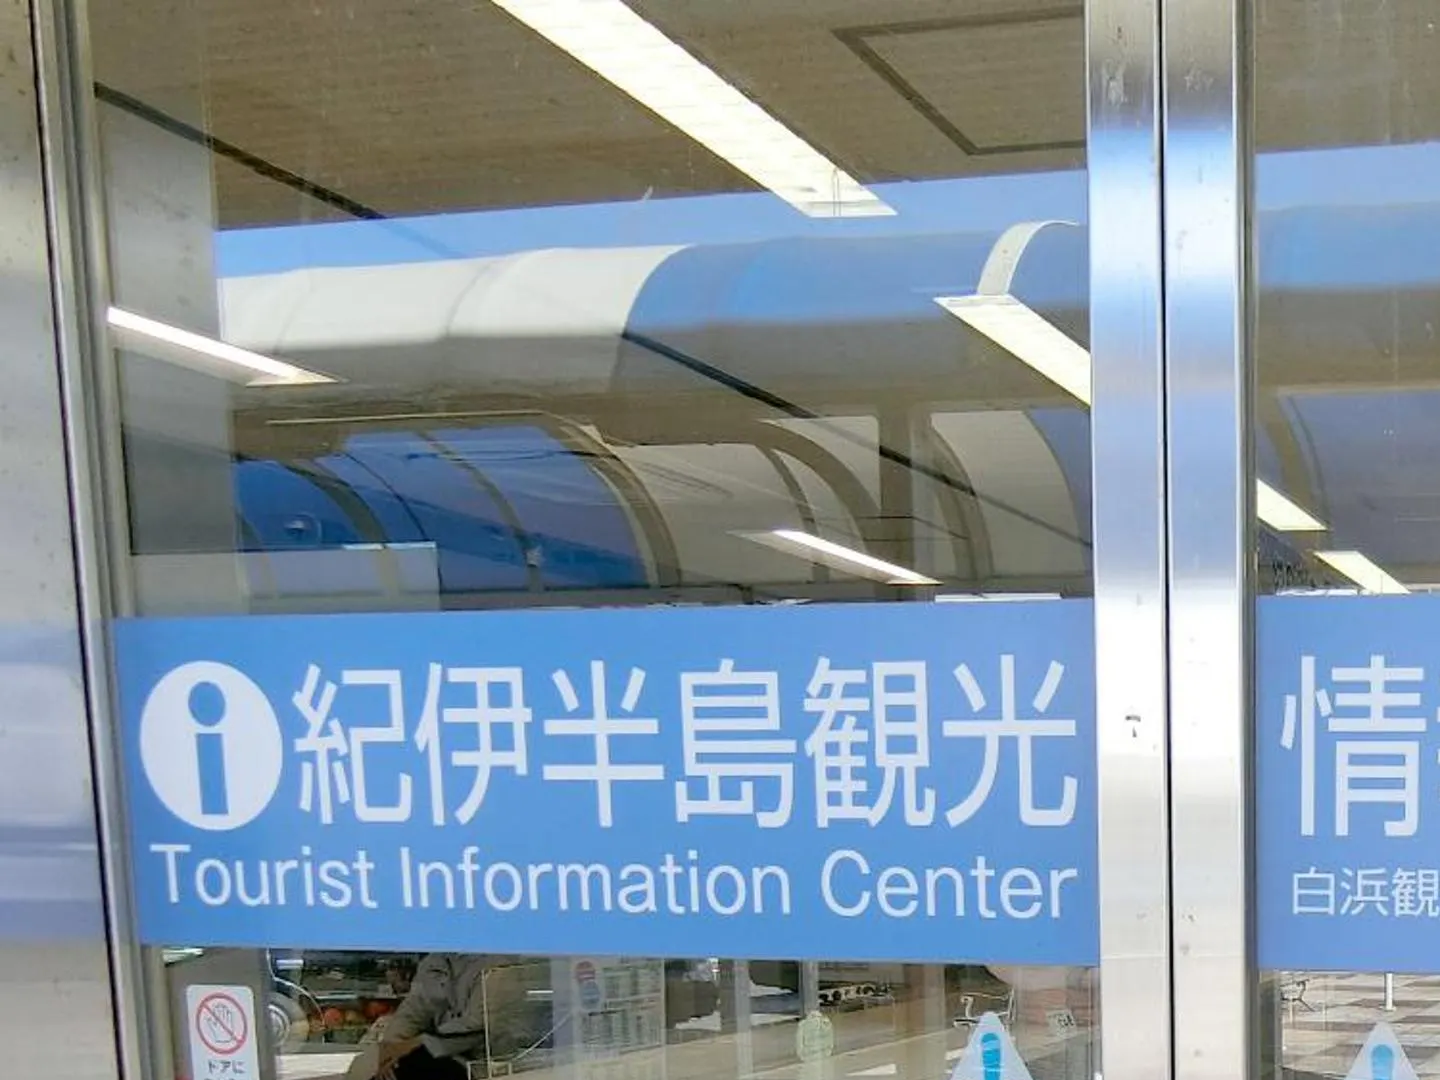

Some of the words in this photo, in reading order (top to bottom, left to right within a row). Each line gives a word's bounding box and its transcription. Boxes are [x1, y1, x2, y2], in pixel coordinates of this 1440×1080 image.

[292, 654, 1078, 828] 紀伊半島観光
[150, 843, 378, 908] Tourist
[401, 846, 790, 914] Information
[821, 850, 1078, 918] Center
